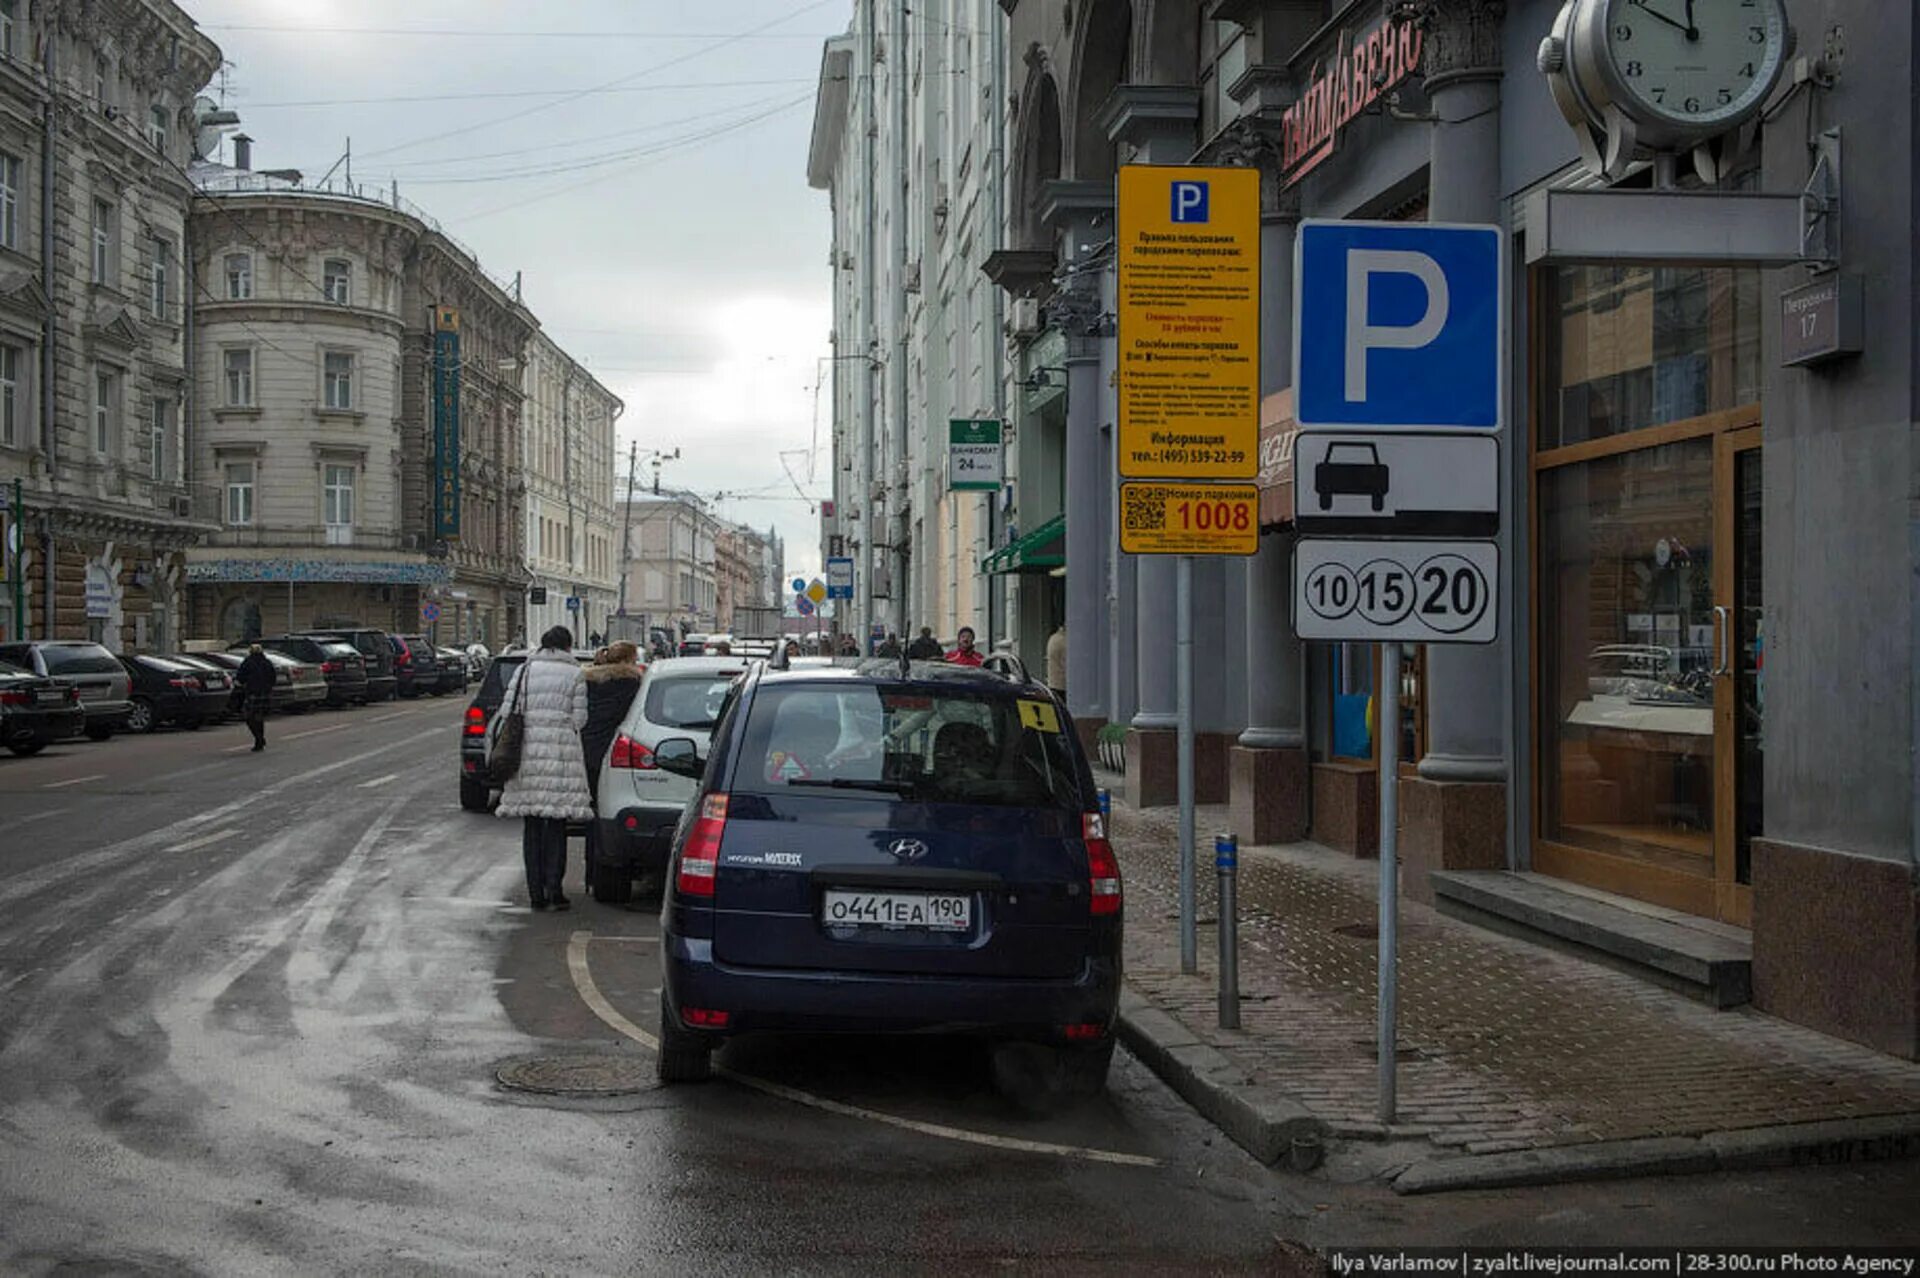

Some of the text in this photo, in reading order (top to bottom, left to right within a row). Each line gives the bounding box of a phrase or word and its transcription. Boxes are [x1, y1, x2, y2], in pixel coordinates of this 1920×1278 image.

[1616, 25, 1632, 42] 9
[1749, 27, 1765, 44] 3
[1626, 61, 1643, 77] 8
[1738, 62, 1754, 77] 4
[1652, 88, 1666, 104] 7
[1717, 89, 1732, 105] 5
[1684, 97, 1699, 113] 6
[1178, 184, 1201, 220] P
[1345, 248, 1450, 402] P
[1801, 313, 1816, 338] 17
[1151, 432, 1225, 447] Информация
[958, 458, 974, 470] 24
[1160, 450, 1189, 464] (495)
[1167, 489, 1203, 500] Номер
[1177, 502, 1249, 530] 1008
[1312, 566, 1477, 615] 10 15 20
[930, 898, 963, 917] 190
